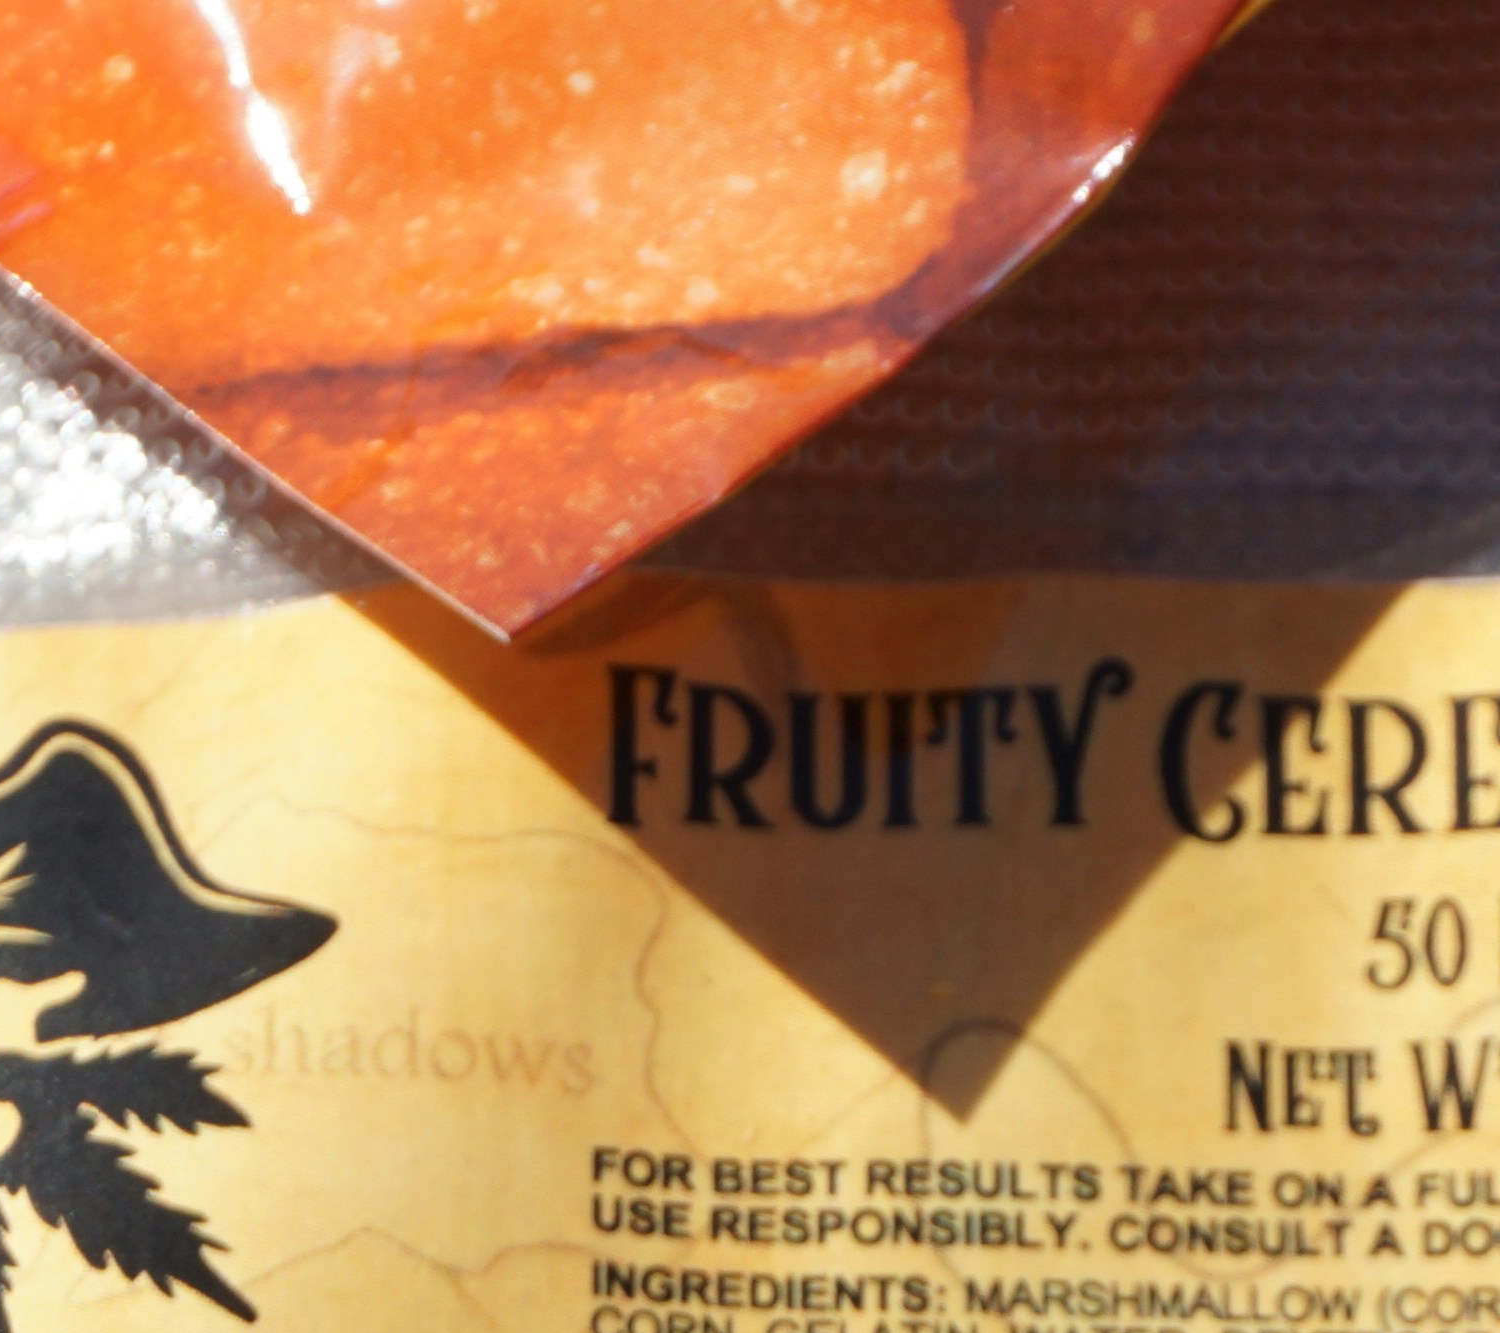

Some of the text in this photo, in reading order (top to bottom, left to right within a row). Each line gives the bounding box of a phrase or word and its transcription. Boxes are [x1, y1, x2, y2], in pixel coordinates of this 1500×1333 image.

[606, 657, 1136, 832] FRUITY
[1364, 895, 1470, 990] 50
[592, 1146, 694, 1191] FOR
[712, 1158, 845, 1197] BEST
[866, 1160, 1100, 1200] RESULTS
[1121, 1164, 1253, 1205] TAKE
[1272, 1171, 1344, 1207] ON
[1365, 1176, 1395, 1206] A
[593, 1194, 691, 1239] USE
[710, 1205, 1092, 1249] RESPONSIBLY.
[1108, 1214, 1351, 1256] CONSULT
[1371, 1223, 1400, 1256] A
[593, 1259, 947, 1313] INGREDIENTS:
[965, 1278, 1361, 1323] MARSHMALLOW
